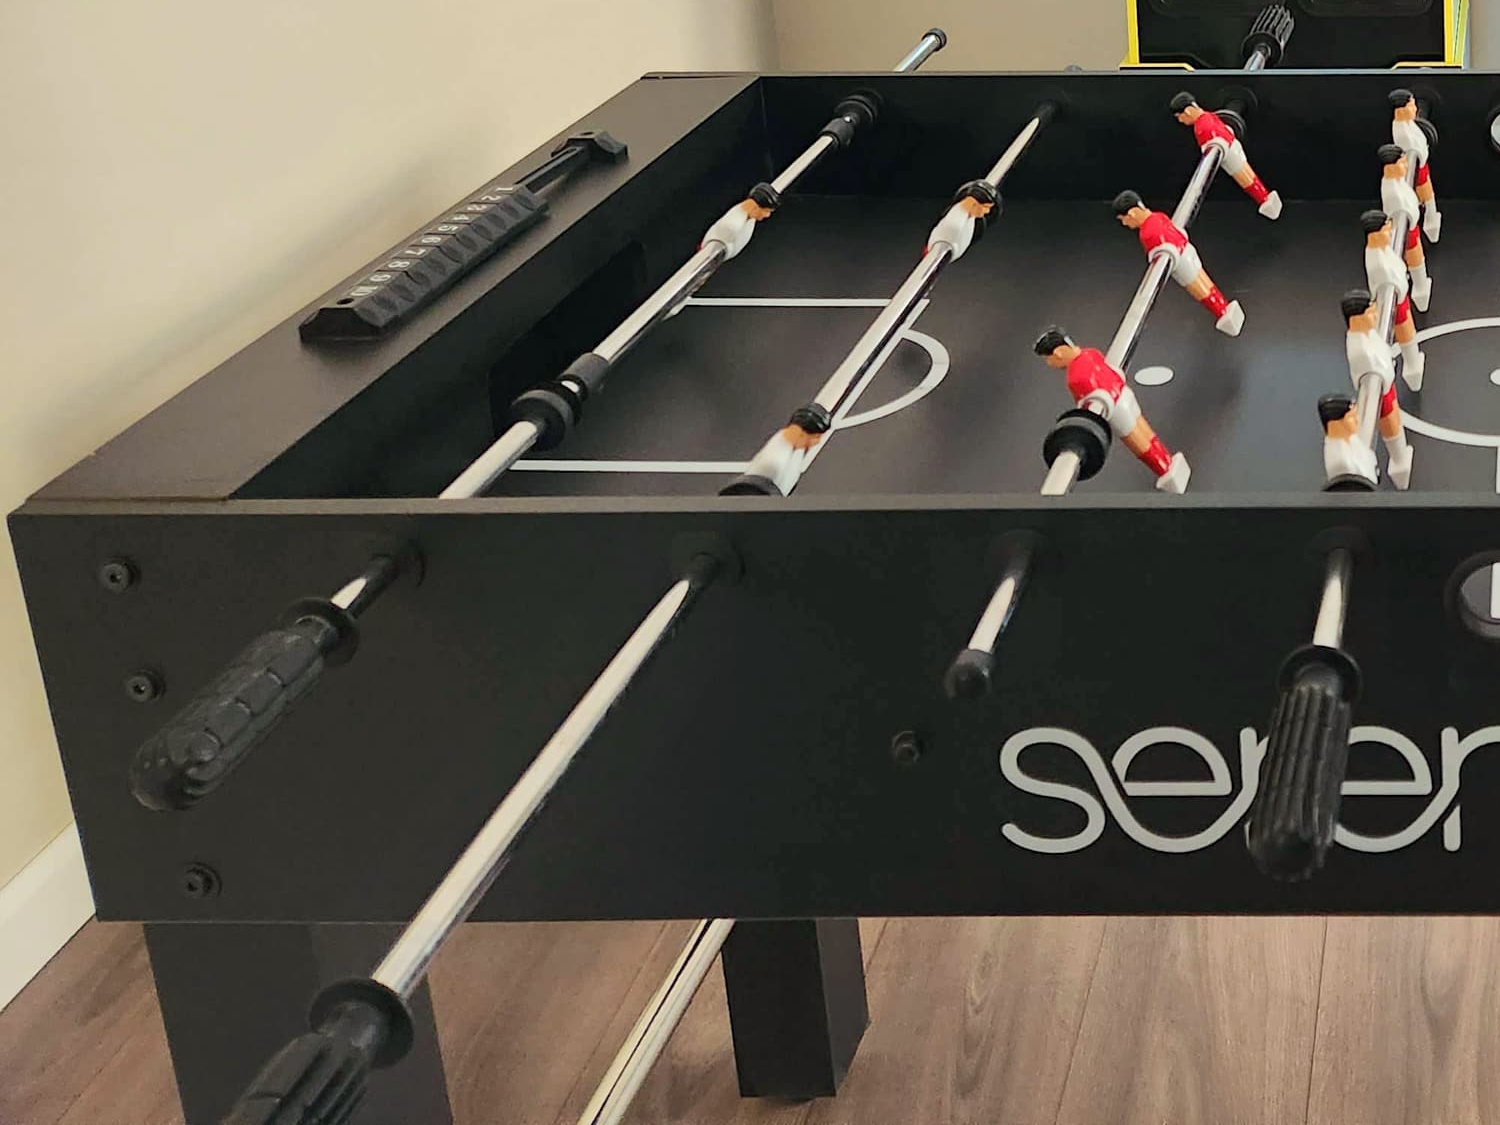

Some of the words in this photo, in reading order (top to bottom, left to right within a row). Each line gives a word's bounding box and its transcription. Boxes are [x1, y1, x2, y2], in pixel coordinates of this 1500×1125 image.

[421, 236, 442, 244] 6
[405, 248, 426, 256] 7
[388, 260, 410, 268] 8
[369, 274, 392, 282] 9
[350, 285, 379, 297] 10
